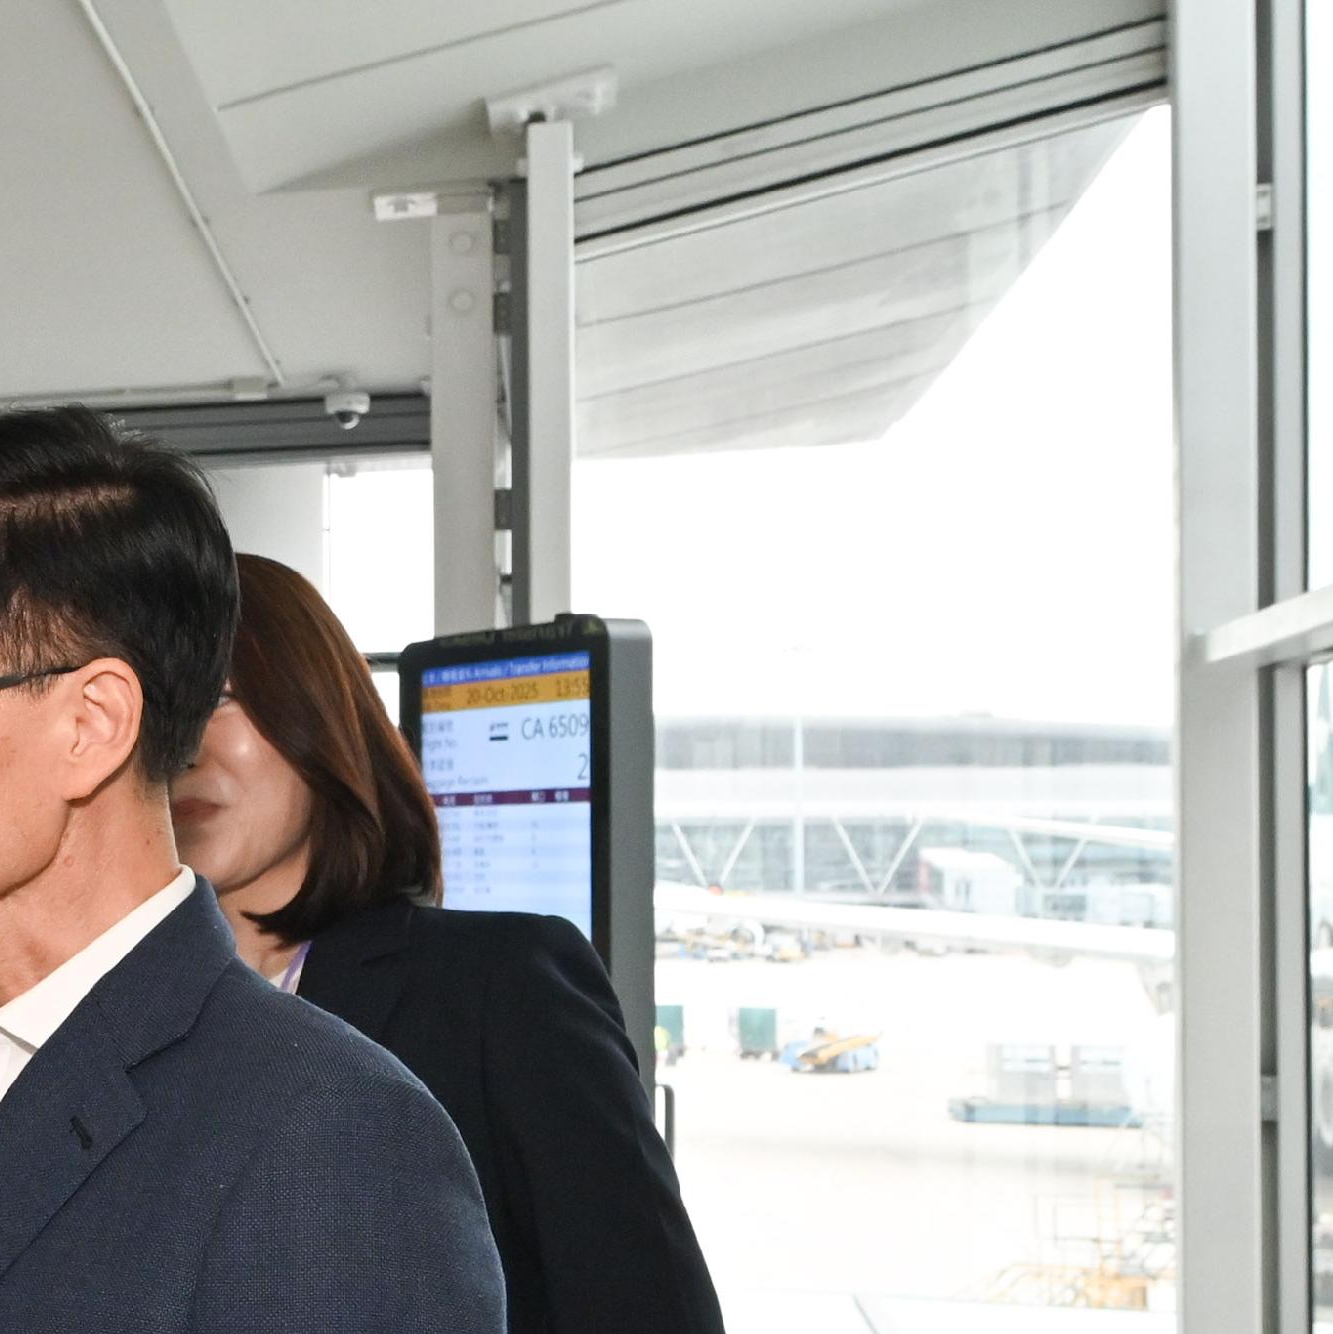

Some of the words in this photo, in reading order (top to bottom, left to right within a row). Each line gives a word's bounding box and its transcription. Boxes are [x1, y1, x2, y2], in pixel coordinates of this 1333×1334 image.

[521, 717, 544, 740] CA
[549, 714, 590, 738] 6509
[577, 753, 589, 780] 2
